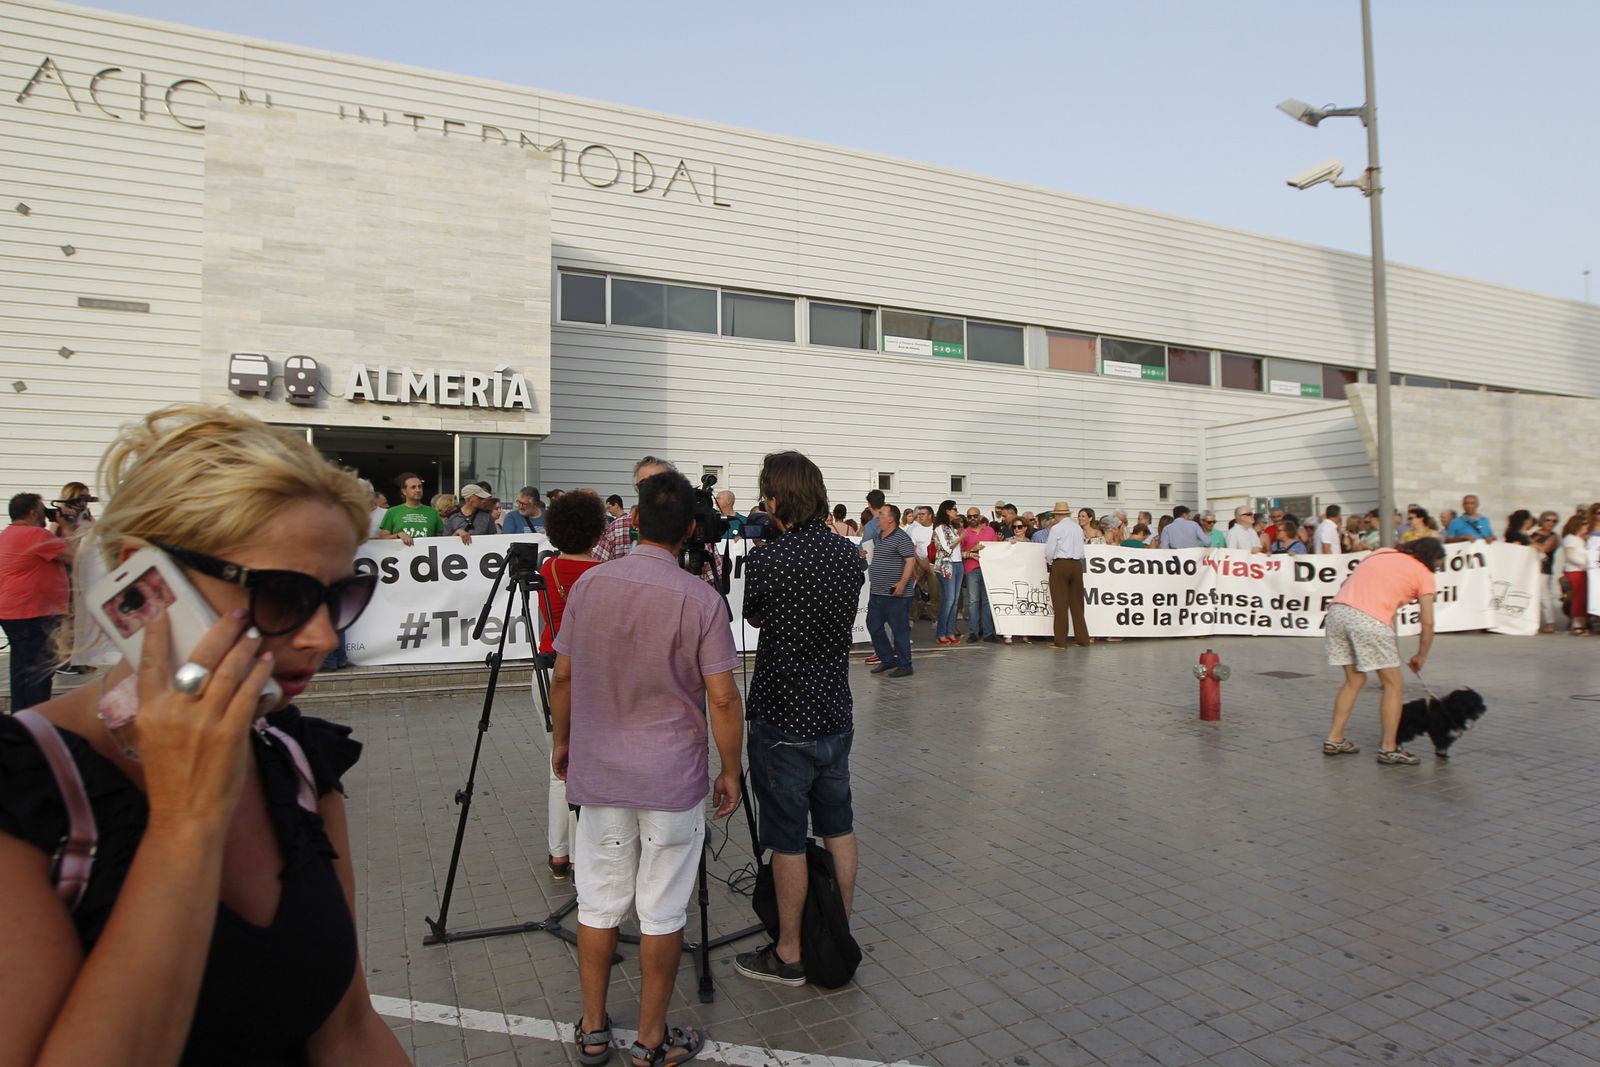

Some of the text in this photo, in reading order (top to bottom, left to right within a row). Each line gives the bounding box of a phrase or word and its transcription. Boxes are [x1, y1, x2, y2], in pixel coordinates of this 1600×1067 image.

[344, 362, 532, 410] ALMERÍA
[352, 556, 400, 584] os
[410, 545, 469, 583] de
[1294, 562, 1337, 583] De
[1082, 587, 1144, 606] Mesa
[1152, 592, 1178, 607] en
[1270, 594, 1311, 612] del
[396, 610, 546, 650] #Tren
[1116, 608, 1145, 626] de
[1153, 608, 1172, 626] la
[1280, 612, 1310, 631] de
[346, 641, 366, 652] ERÍA
